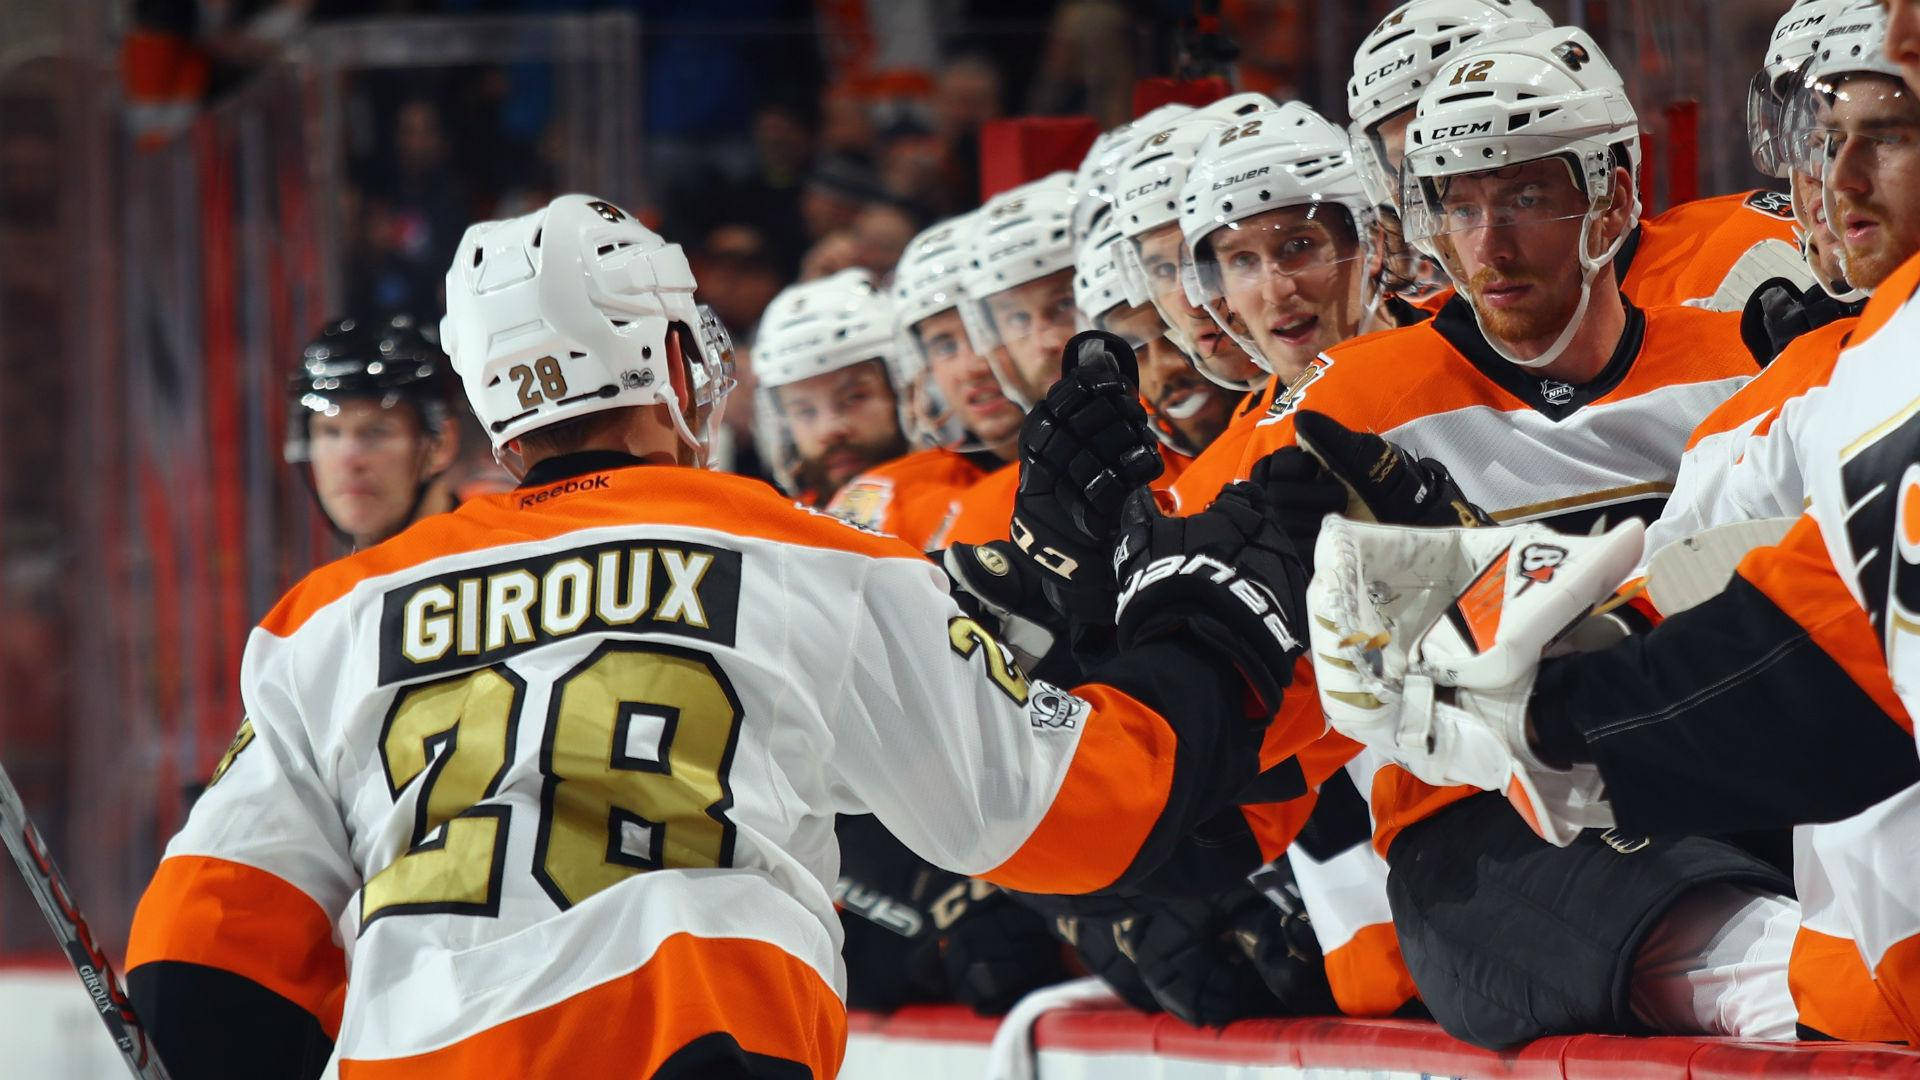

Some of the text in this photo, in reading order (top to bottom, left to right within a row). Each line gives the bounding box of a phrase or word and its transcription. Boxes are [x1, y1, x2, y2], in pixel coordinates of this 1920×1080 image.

[1775, 14, 1827, 40] CCM
[1364, 54, 1415, 86] CCM
[1449, 60, 1495, 86] 12
[1219, 120, 1262, 147] 22
[1430, 120, 1492, 140] CCM
[1125, 177, 1172, 201] CCM
[510, 355, 568, 410] 28
[1549, 387, 1569, 398] NHL
[519, 475, 610, 510] Reebok
[402, 547, 714, 664] GIROUX
[356, 638, 745, 940] 28
[80, 964, 114, 1014] GIROUX
